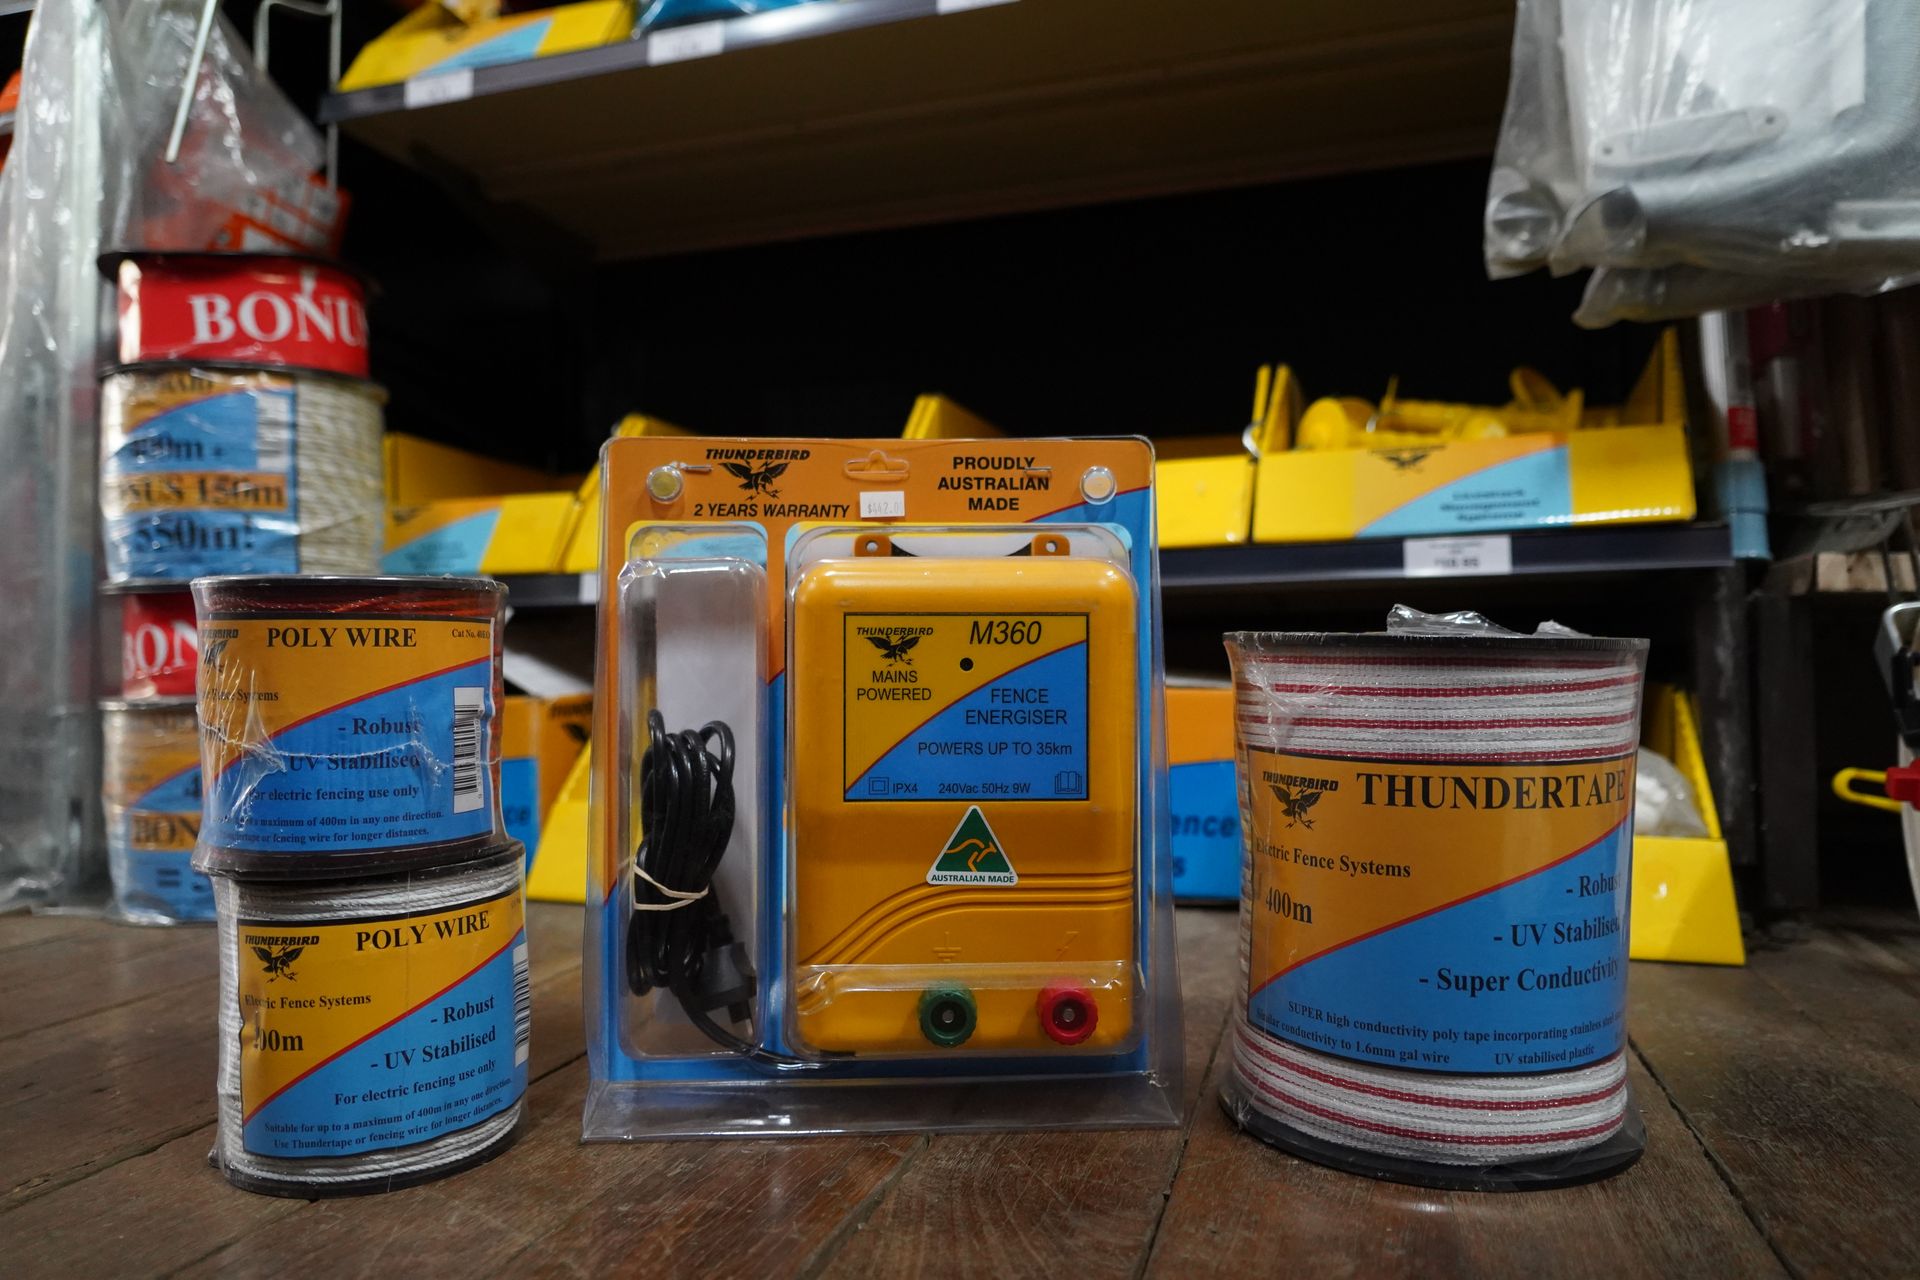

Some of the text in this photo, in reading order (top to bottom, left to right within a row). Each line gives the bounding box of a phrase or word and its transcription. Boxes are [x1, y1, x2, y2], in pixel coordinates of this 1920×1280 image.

[705, 448, 811, 460] THUNDERBIRD
[953, 456, 1035, 470] PROUDLY
[937, 476, 1050, 491] AUSTRALIAN
[694, 503, 850, 518] 2 YEARS WARRANTY
[967, 497, 1020, 511] MADE
[266, 626, 338, 648] POLY
[345, 627, 417, 648] WIRE
[856, 627, 934, 636] THUNDERBIRD
[969, 620, 1042, 645] M360
[872, 670, 918, 684] MAINS
[857, 688, 932, 701] POWERED
[991, 688, 1049, 704] FENCE
[352, 717, 421, 736] Robust
[965, 709, 1068, 725] ENERGISER
[918, 742, 1073, 755] POWERS UP TO 35km
[289, 753, 322, 772] UV
[892, 781, 918, 794] IPX4
[938, 781, 1031, 794] 240Vac 50Hz 9W
[1262, 770, 1339, 792] THUNDERBIRD
[1356, 769, 1626, 810] THUNDERTAPE
[269, 788, 312, 801] electric
[316, 787, 365, 802] fencing
[369, 787, 389, 798] use
[393, 784, 419, 799] only
[306, 817, 317, 826] of
[319, 816, 347, 826] 400m
[350, 815, 360, 825] in
[363, 815, 380, 826] any
[384, 814, 400, 823] one
[309, 833, 330, 843] wire
[334, 831, 349, 842] for
[352, 831, 382, 843] longer
[1293, 848, 1335, 870] Fence
[1339, 855, 1411, 878] Systems
[931, 874, 1015, 883] AUSTRALIAN MADE
[1265, 886, 1313, 924] 400m
[245, 910, 490, 952] THUNDERBIRD POLY WIRE
[1511, 924, 1547, 947] UV
[1437, 967, 1510, 998] Super
[1517, 956, 1618, 992] Conductivity
[280, 997, 316, 1009] Fence
[319, 994, 372, 1010] Systems
[443, 995, 495, 1025] Robust
[1288, 1001, 1323, 1021] SUPER
[1326, 1012, 1350, 1029] high
[1353, 1019, 1429, 1042] conductivity
[1433, 1028, 1459, 1044] poly
[1464, 1030, 1489, 1045] tape
[1493, 1026, 1568, 1044] incorporating
[384, 1049, 416, 1070] UV
[422, 1025, 496, 1063] Stabilised
[1281, 1022, 1339, 1046] conductivity
[1341, 1040, 1352, 1050] to
[1356, 1041, 1395, 1059] 1.6mm
[1400, 1049, 1418, 1063] gal
[1422, 1051, 1450, 1064] wire
[1495, 1043, 1595, 1066] UV stabilised plastic
[335, 1059, 496, 1106] For electric fencing use only
[265, 1122, 298, 1134] Suitable
[301, 1122, 316, 1133] for
[317, 1125, 329, 1136] up
[331, 1123, 342, 1132] to
[353, 1112, 402, 1130] maximum
[406, 1109, 417, 1121] of
[417, 1105, 442, 1117] 400m
[443, 1101, 452, 1110] in
[454, 1097, 469, 1109] any
[471, 1093, 484, 1102] one
[274, 1139, 289, 1149] Use
[293, 1137, 352, 1150] Thundertape
[355, 1135, 367, 1145] or
[369, 1129, 405, 1143] fencing
[407, 1124, 429, 1136] wire
[431, 1119, 443, 1131] for
[445, 1110, 471, 1125] longer
